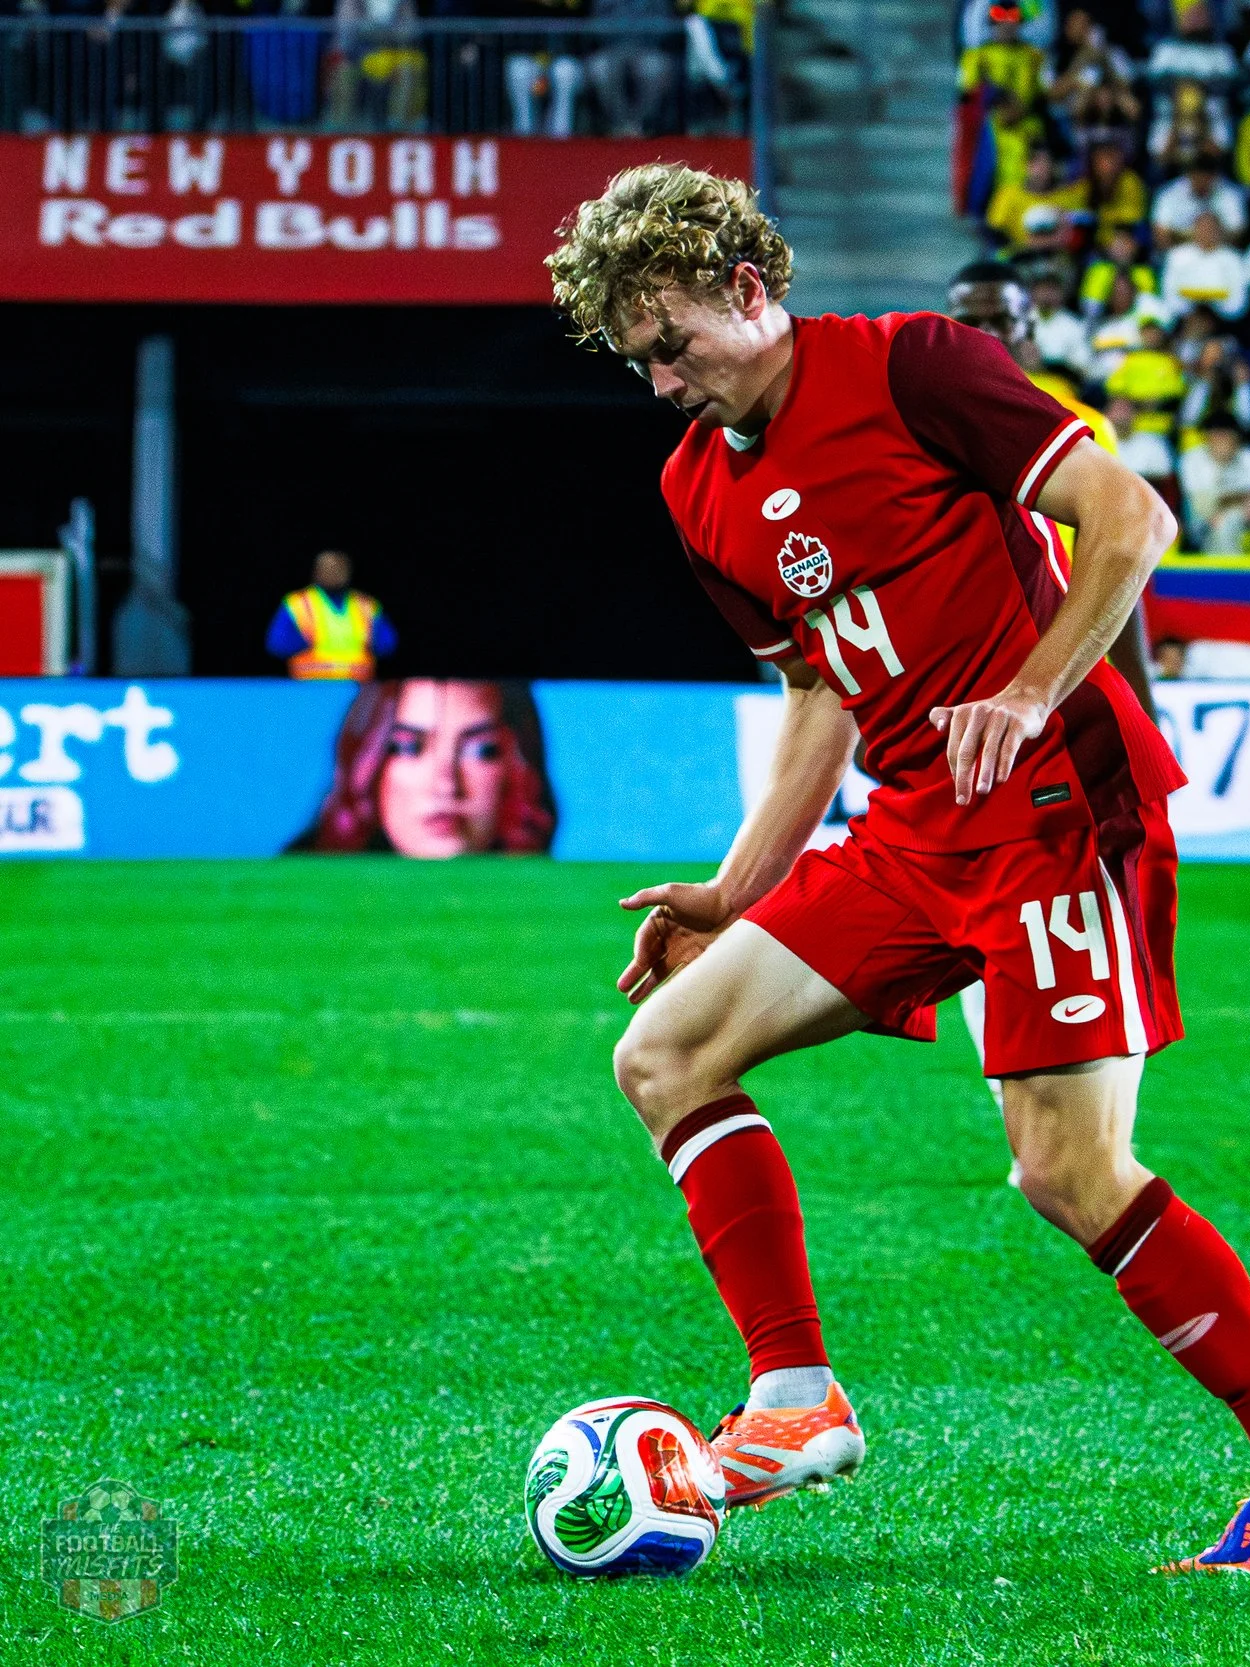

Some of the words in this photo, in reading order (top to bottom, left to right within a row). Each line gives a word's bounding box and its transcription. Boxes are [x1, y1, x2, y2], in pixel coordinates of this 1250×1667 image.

[42, 135, 223, 196] NEW
[39, 199, 241, 248] Red
[254, 199, 503, 249] Bulls
[782, 552, 828, 580] CANADA
[803, 584, 906, 696] 14
[0, 685, 180, 783] rt
[1019, 890, 1110, 991] 14
